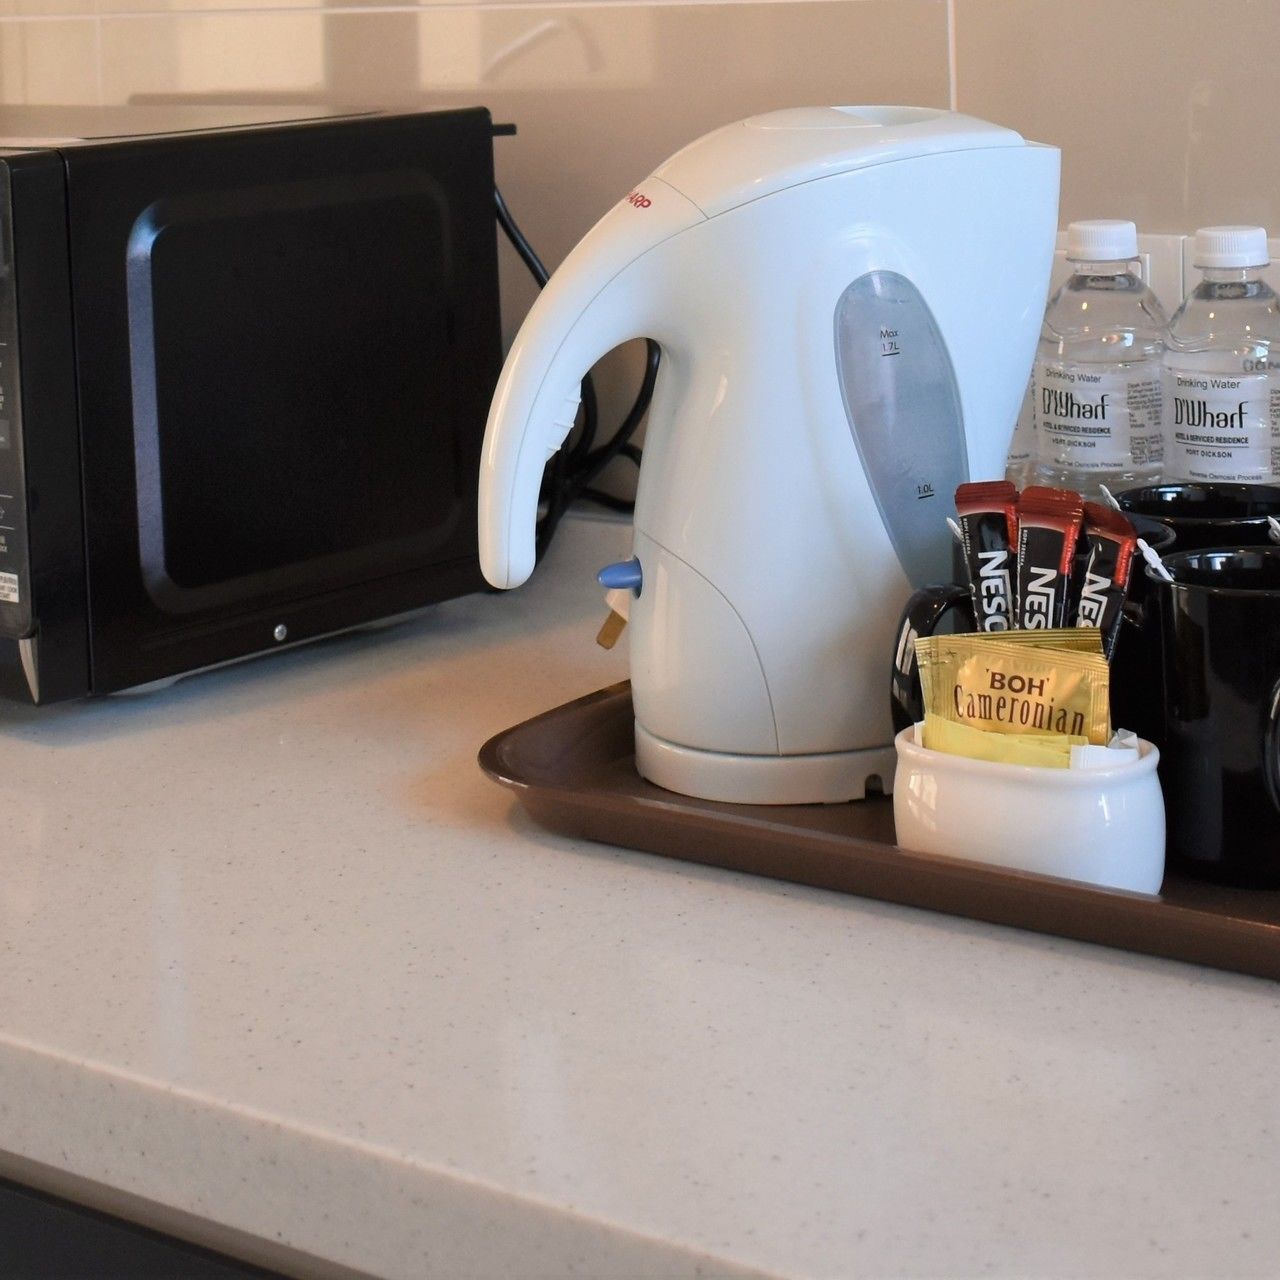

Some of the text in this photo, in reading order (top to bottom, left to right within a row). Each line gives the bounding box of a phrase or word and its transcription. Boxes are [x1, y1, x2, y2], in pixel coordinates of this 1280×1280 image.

[627, 191, 652, 208] ARP
[880, 330, 898, 339] Max
[882, 342, 899, 351] 1.7L
[1046, 369, 1102, 383] Drinking Water
[1177, 377, 1241, 390] Drinking Water
[1082, 426, 1111, 434] RESIDENCE
[1067, 439, 1096, 447] DICKSON
[1215, 436, 1249, 444] RESIDENCE
[1200, 450, 1232, 458] DICKSON
[917, 483, 934, 494] 1.0L
[978, 550, 1014, 632] NESC
[1024, 566, 1058, 629] NES
[954, 684, 1085, 736] Cameronian
